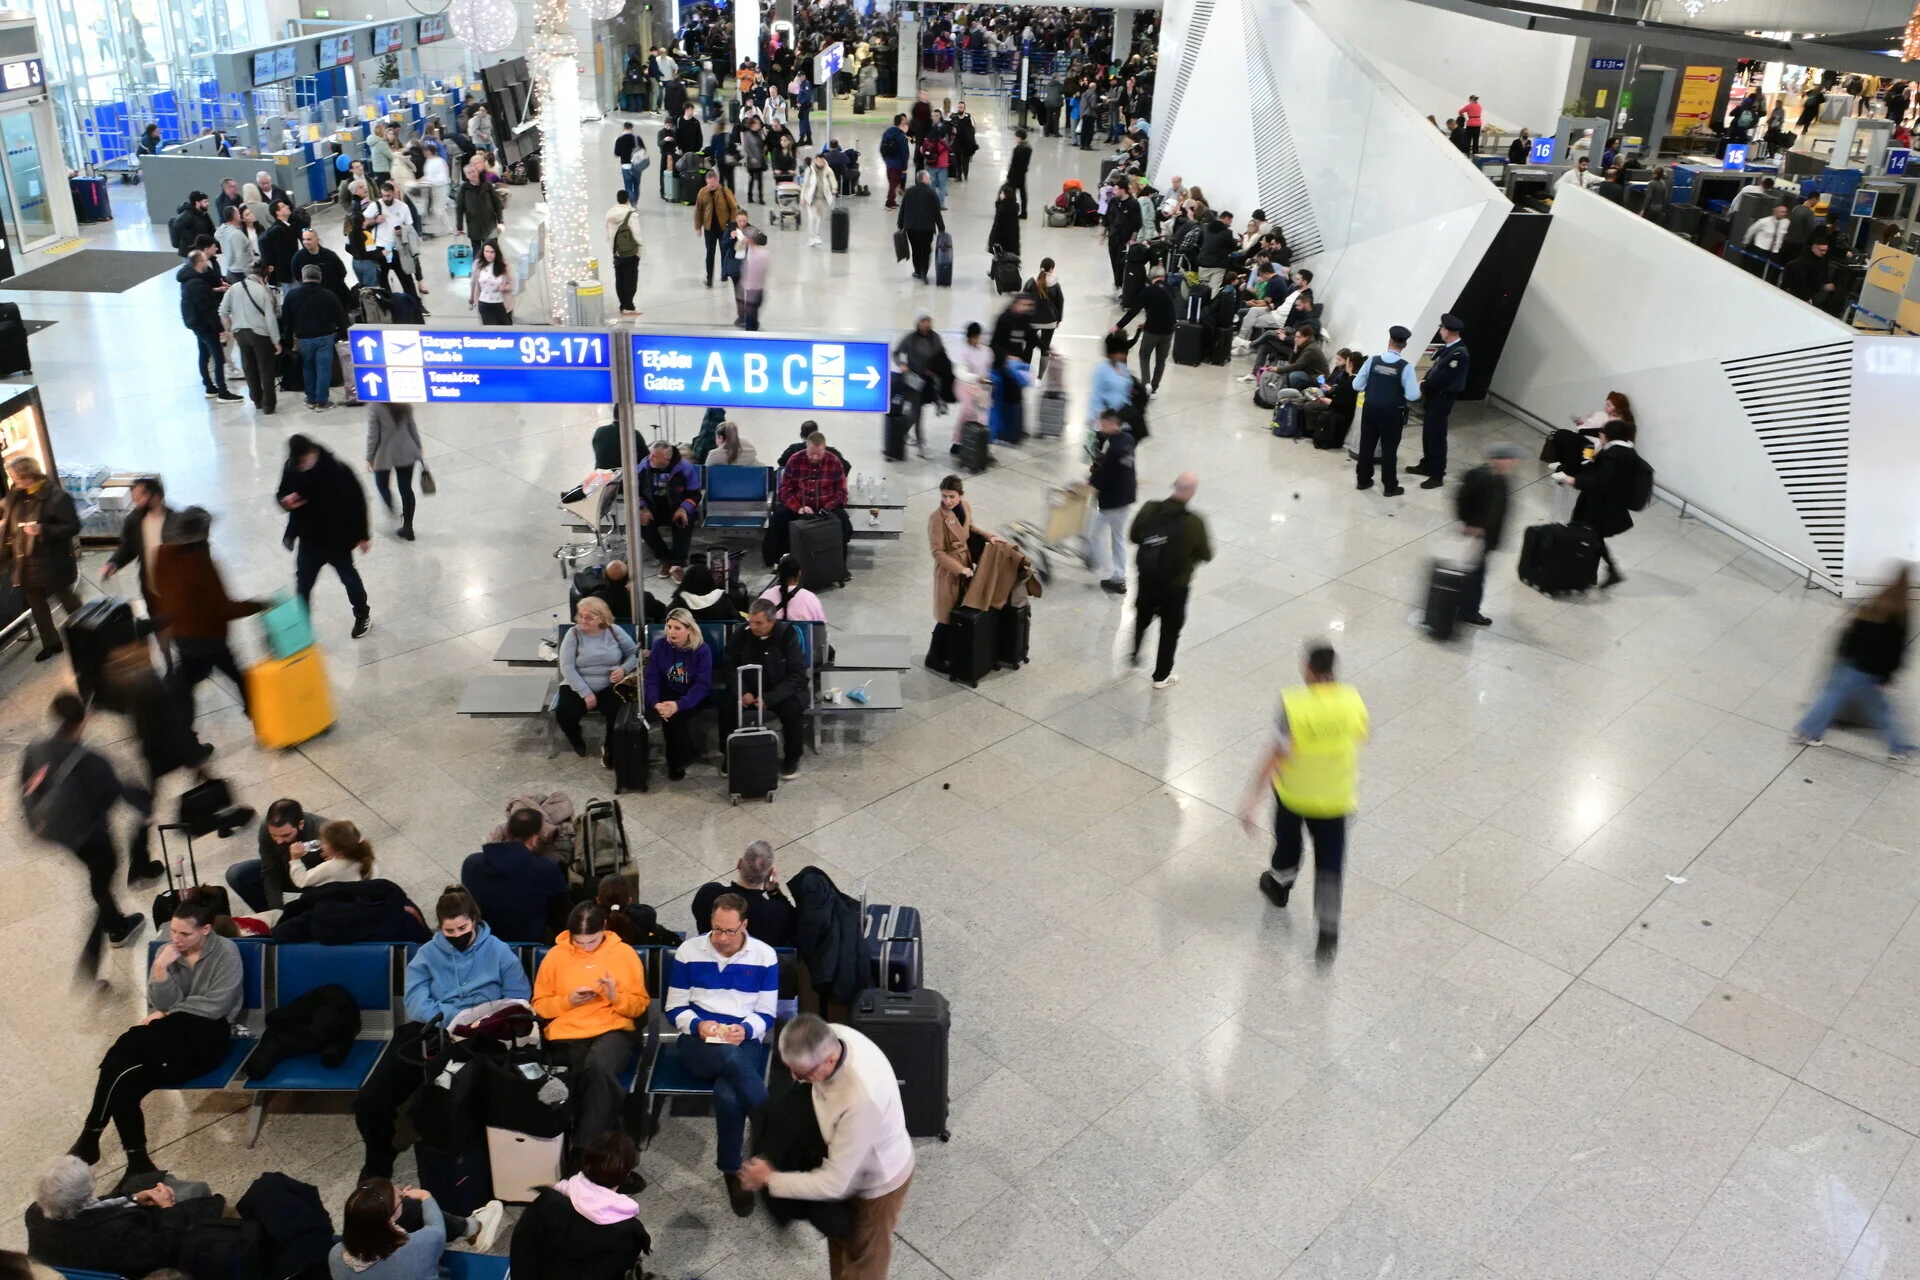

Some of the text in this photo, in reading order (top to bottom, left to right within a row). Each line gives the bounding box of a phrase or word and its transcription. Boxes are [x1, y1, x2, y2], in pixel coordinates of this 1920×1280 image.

[1595, 60, 1616, 68] B 1-31
[29, 61, 41, 84] 3
[1535, 143, 1551, 157] 16
[1728, 149, 1744, 164] 15
[1891, 156, 1905, 169] 14
[424, 351, 462, 362] Check-in
[520, 336, 602, 363] 93-171
[637, 350, 693, 371] Έξοδοι
[428, 371, 480, 385] Τουαλέτες
[700, 351, 809, 396] A B C
[643, 372, 685, 391] Gates
[430, 385, 461, 398] Toilets
